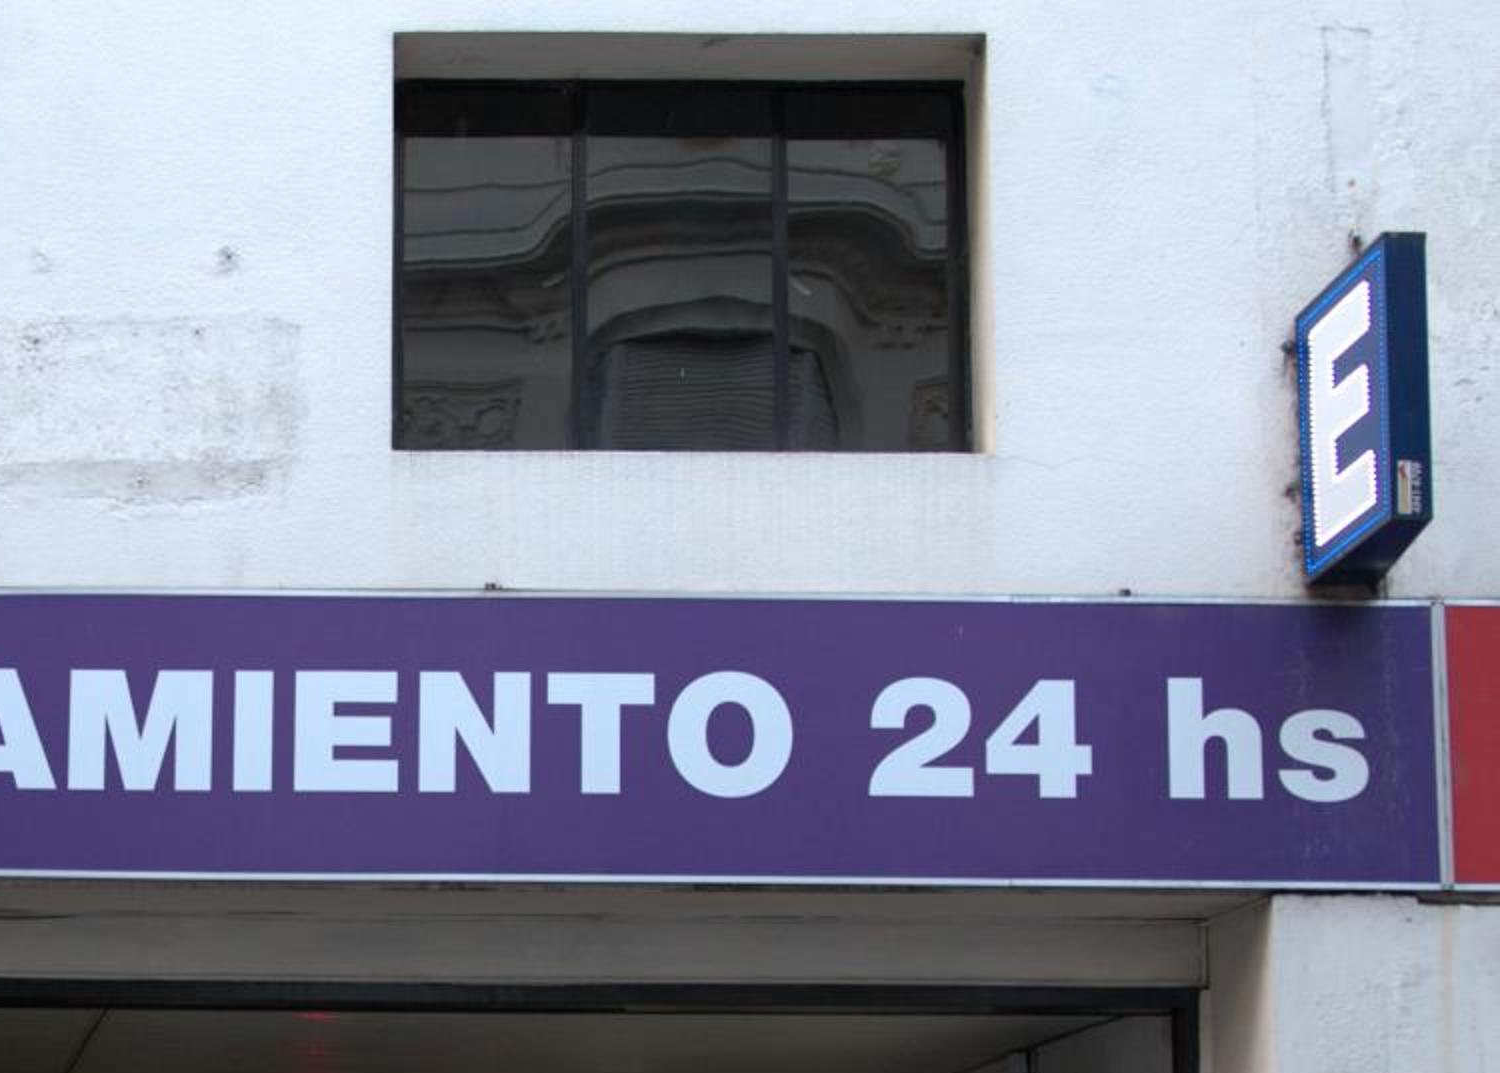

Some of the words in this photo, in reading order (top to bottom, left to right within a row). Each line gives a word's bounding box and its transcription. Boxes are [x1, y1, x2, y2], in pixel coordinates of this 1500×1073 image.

[1307, 280, 1378, 548] E
[868, 676, 1093, 799] 24
[1167, 677, 1369, 803] hs
